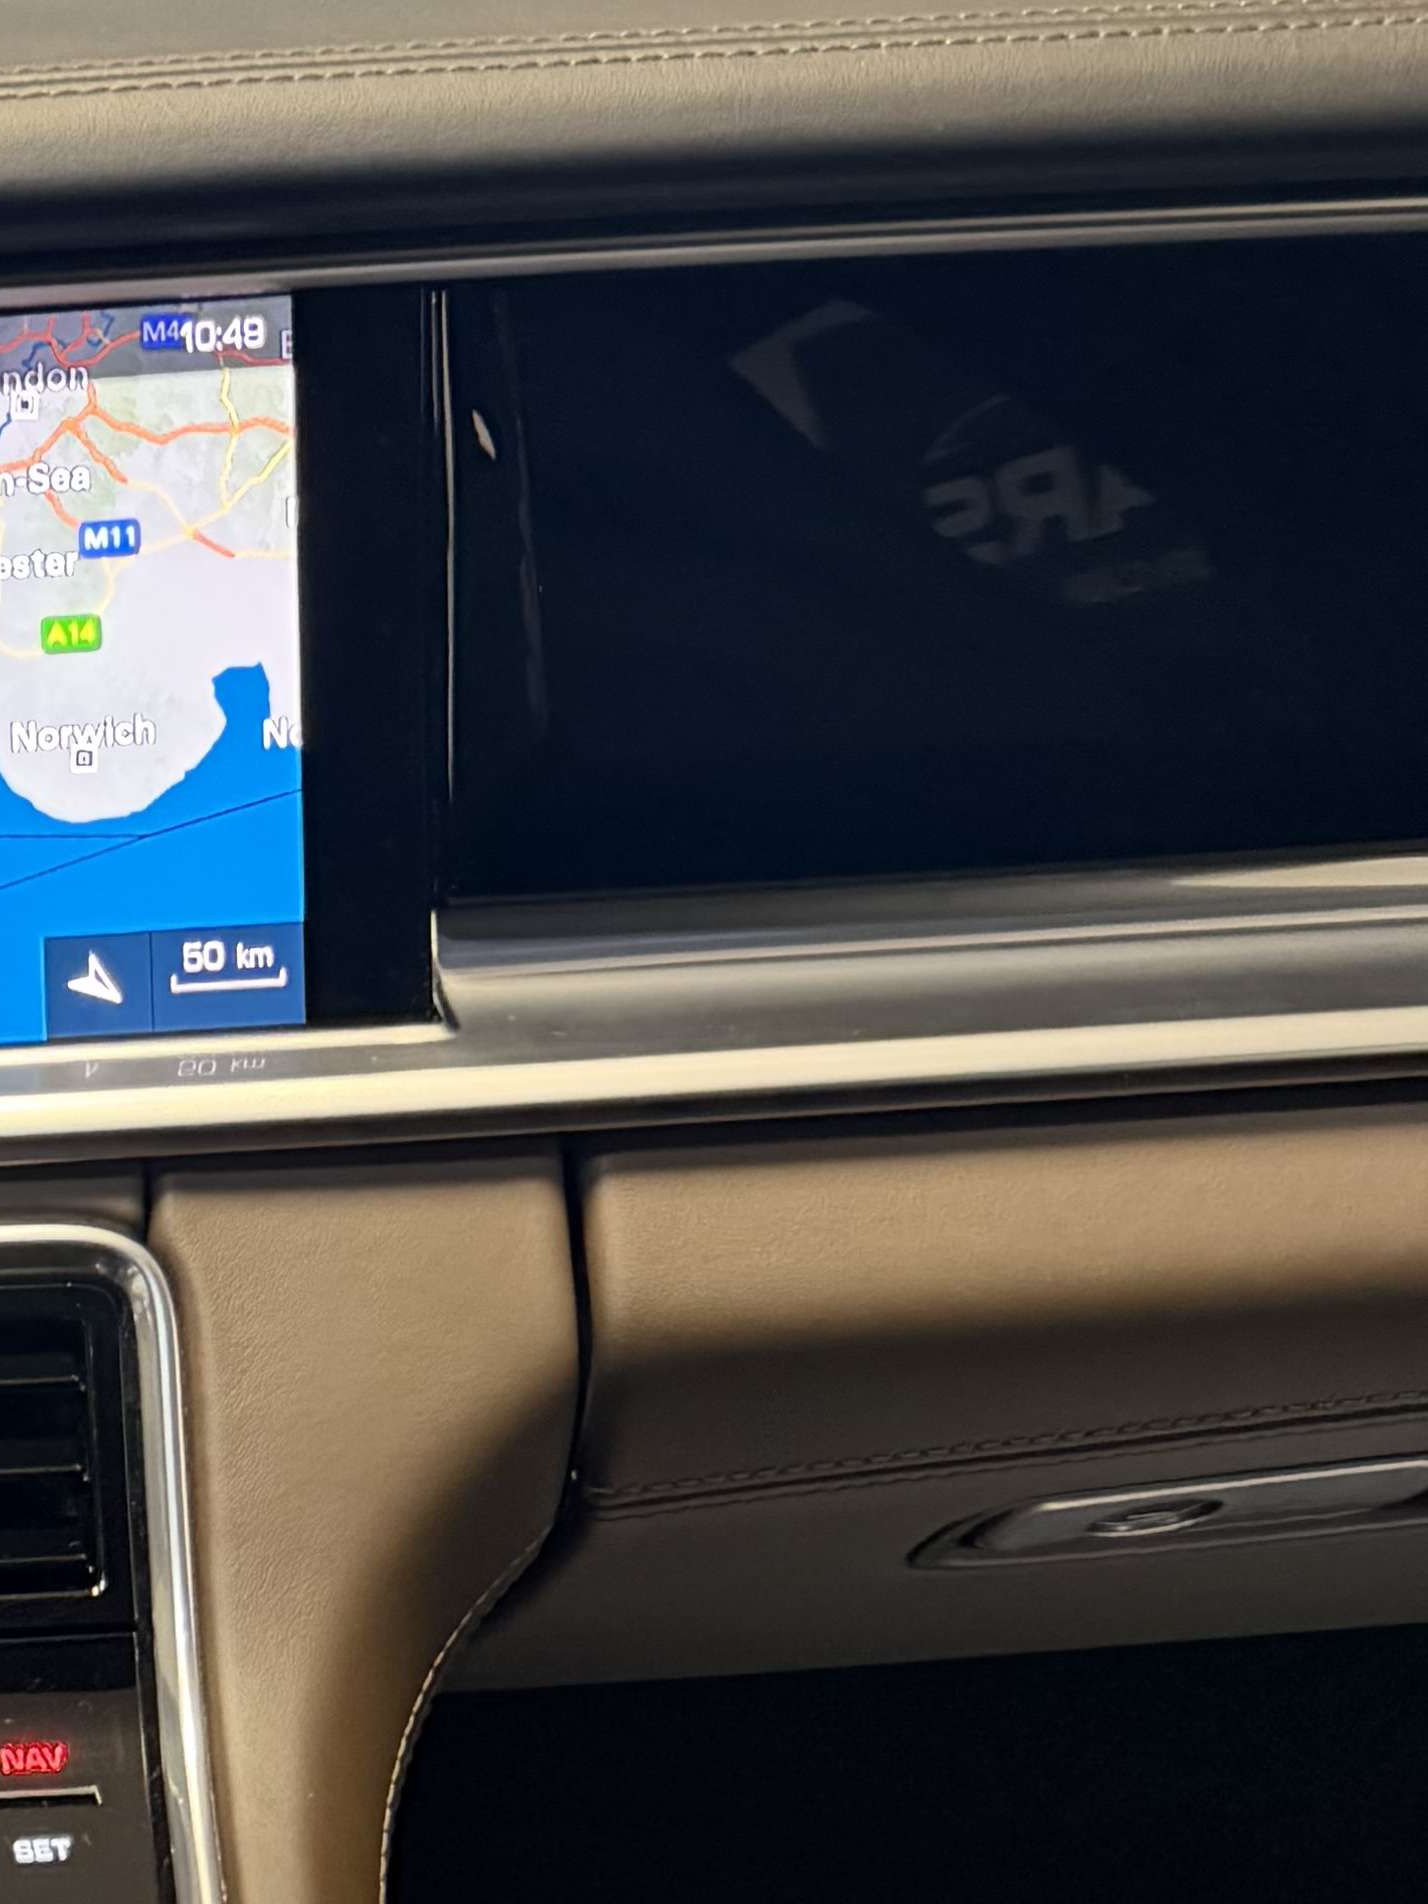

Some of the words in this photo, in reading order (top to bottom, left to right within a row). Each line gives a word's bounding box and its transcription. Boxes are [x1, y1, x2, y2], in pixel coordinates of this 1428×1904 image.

[180, 315, 266, 353] 10:49
[84, 526, 134, 550] M11
[46, 620, 96, 647] A14
[10, 715, 157, 753] Norwich
[182, 942, 225, 972] 50
[237, 941, 275, 969] km
[0, 1742, 68, 1773] NAV
[14, 1837, 71, 1863] SET
